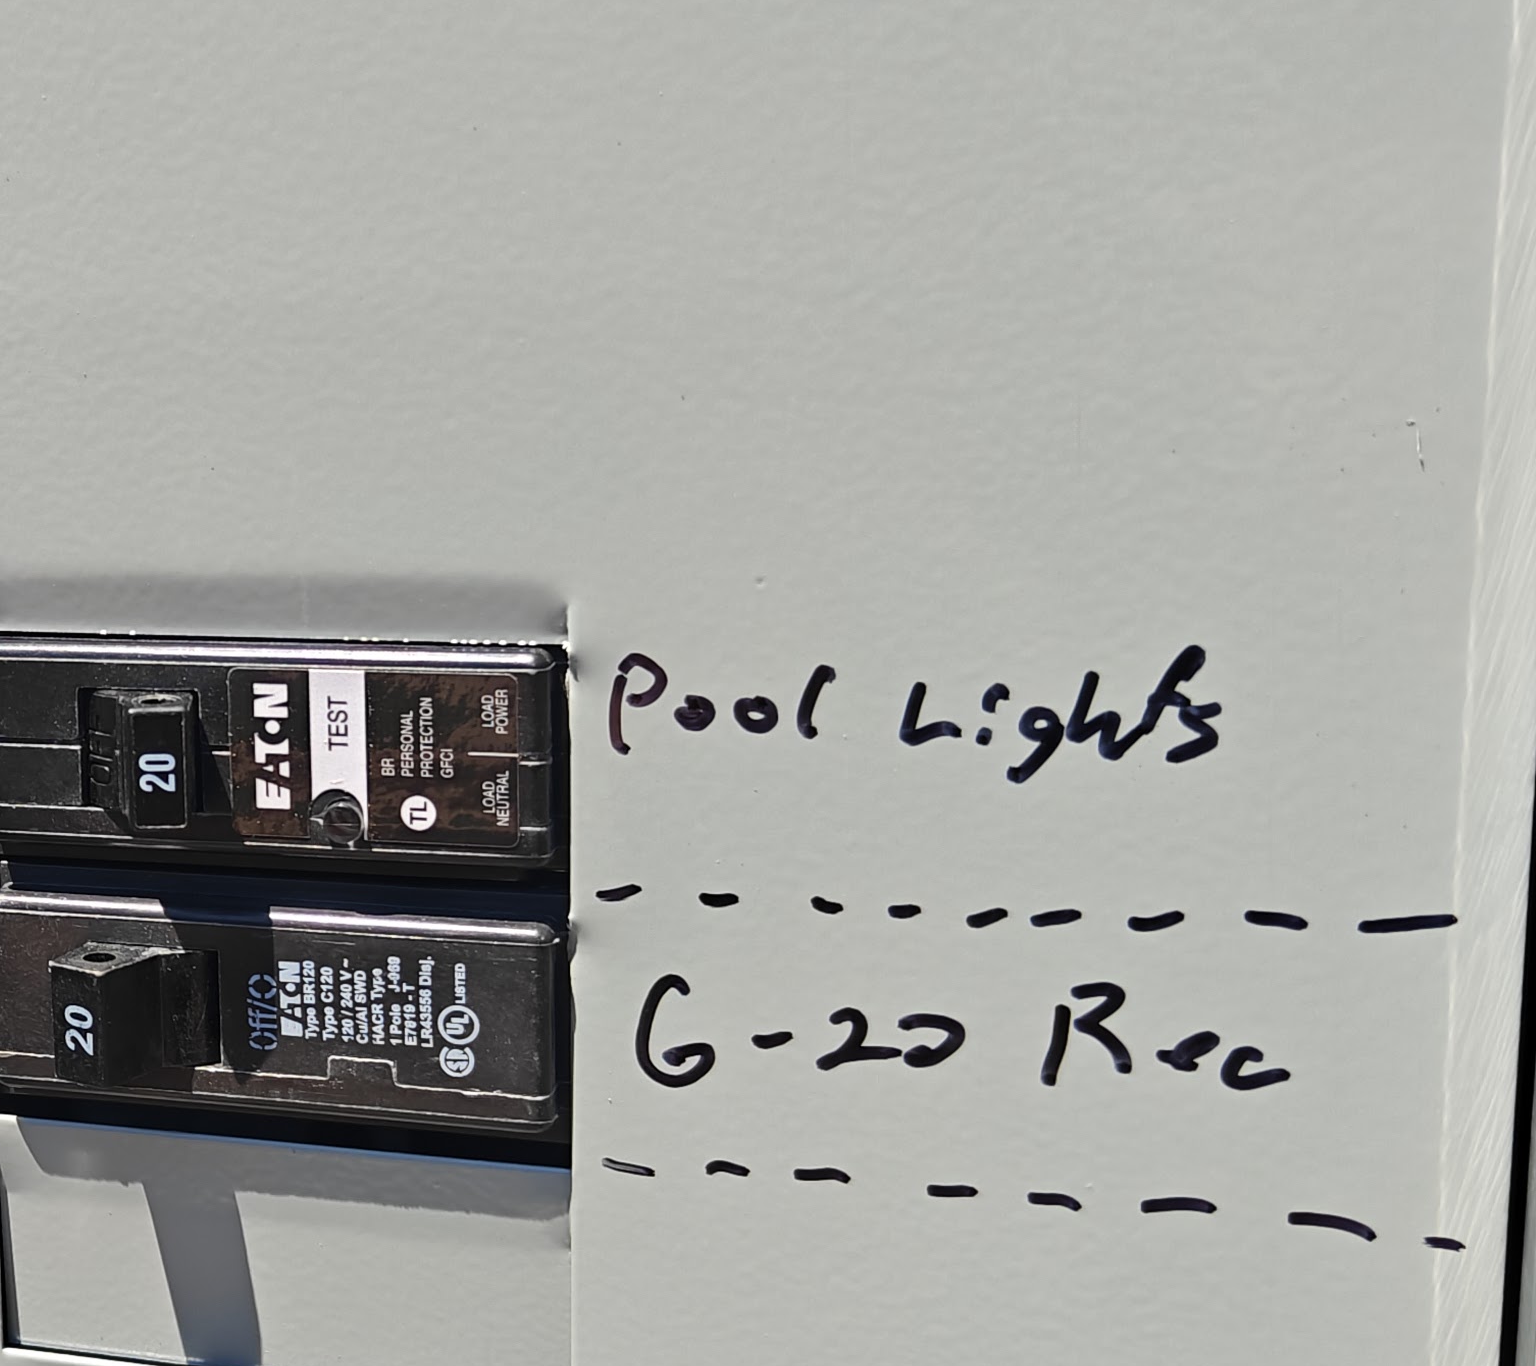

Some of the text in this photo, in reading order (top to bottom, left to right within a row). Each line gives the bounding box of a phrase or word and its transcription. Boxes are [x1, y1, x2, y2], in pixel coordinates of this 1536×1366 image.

[326, 695, 349, 752] TEST
[419, 696, 434, 778] PROTECTION
[481, 694, 495, 728] LOAD
[495, 688, 509, 734] POWER
[609, 644, 1223, 784] Pool Lights
[252, 682, 292, 811] EATON
[380, 757, 396, 777] BR
[400, 709, 415, 778] PERSONAL
[440, 747, 455, 779] GFCI
[138, 753, 177, 793] 20
[482, 780, 496, 814] LOAD
[496, 770, 510, 827] NEUTRAL
[278, 960, 303, 1037] EATON
[302, 960, 320, 1040] Type BR120
[320, 966, 339, 1041] Type C120
[354, 970, 367, 1004] SWD
[370, 968, 386, 1045] HACR Type
[454, 962, 466, 1004] LISTED
[64, 1004, 94, 1056] 20
[389, 1003, 402, 1035] Pole
[1041, 981, 1292, 1091] Rec
